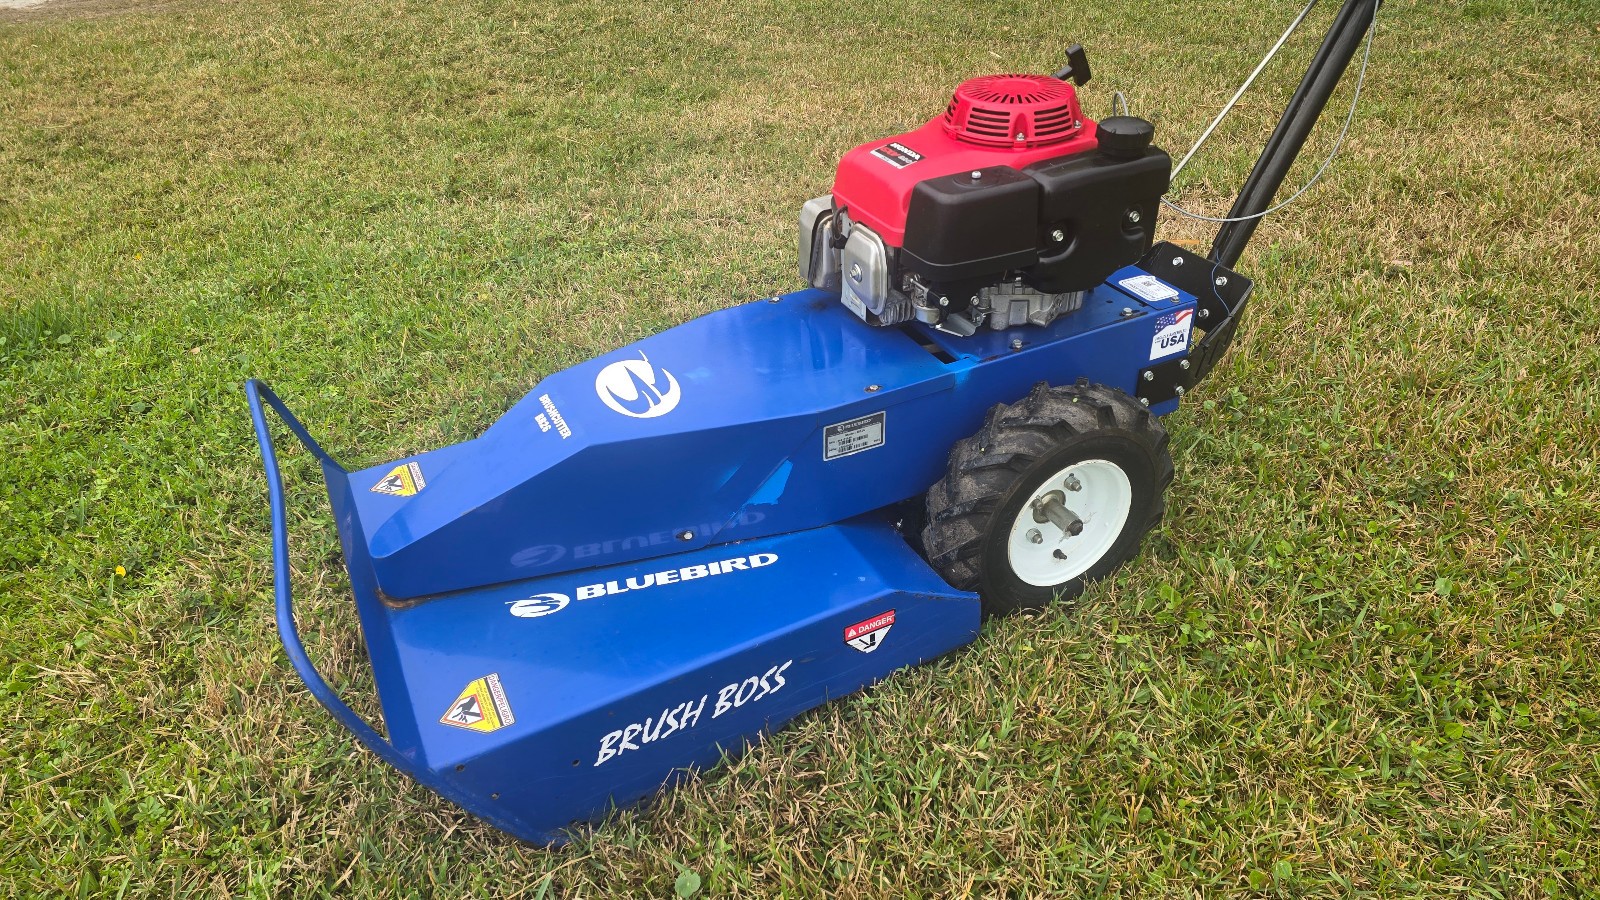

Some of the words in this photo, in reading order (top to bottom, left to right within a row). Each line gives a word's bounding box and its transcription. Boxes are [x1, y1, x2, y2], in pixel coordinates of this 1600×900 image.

[889, 142, 921, 161] HONDA
[1160, 333, 1185, 349] USA
[538, 393, 572, 440] BRUSHCUTTER
[576, 553, 779, 601] BLUEBIRD
[858, 615, 893, 634] DANGER
[593, 694, 708, 767] BRUSH
[711, 659, 793, 719] BOSS
